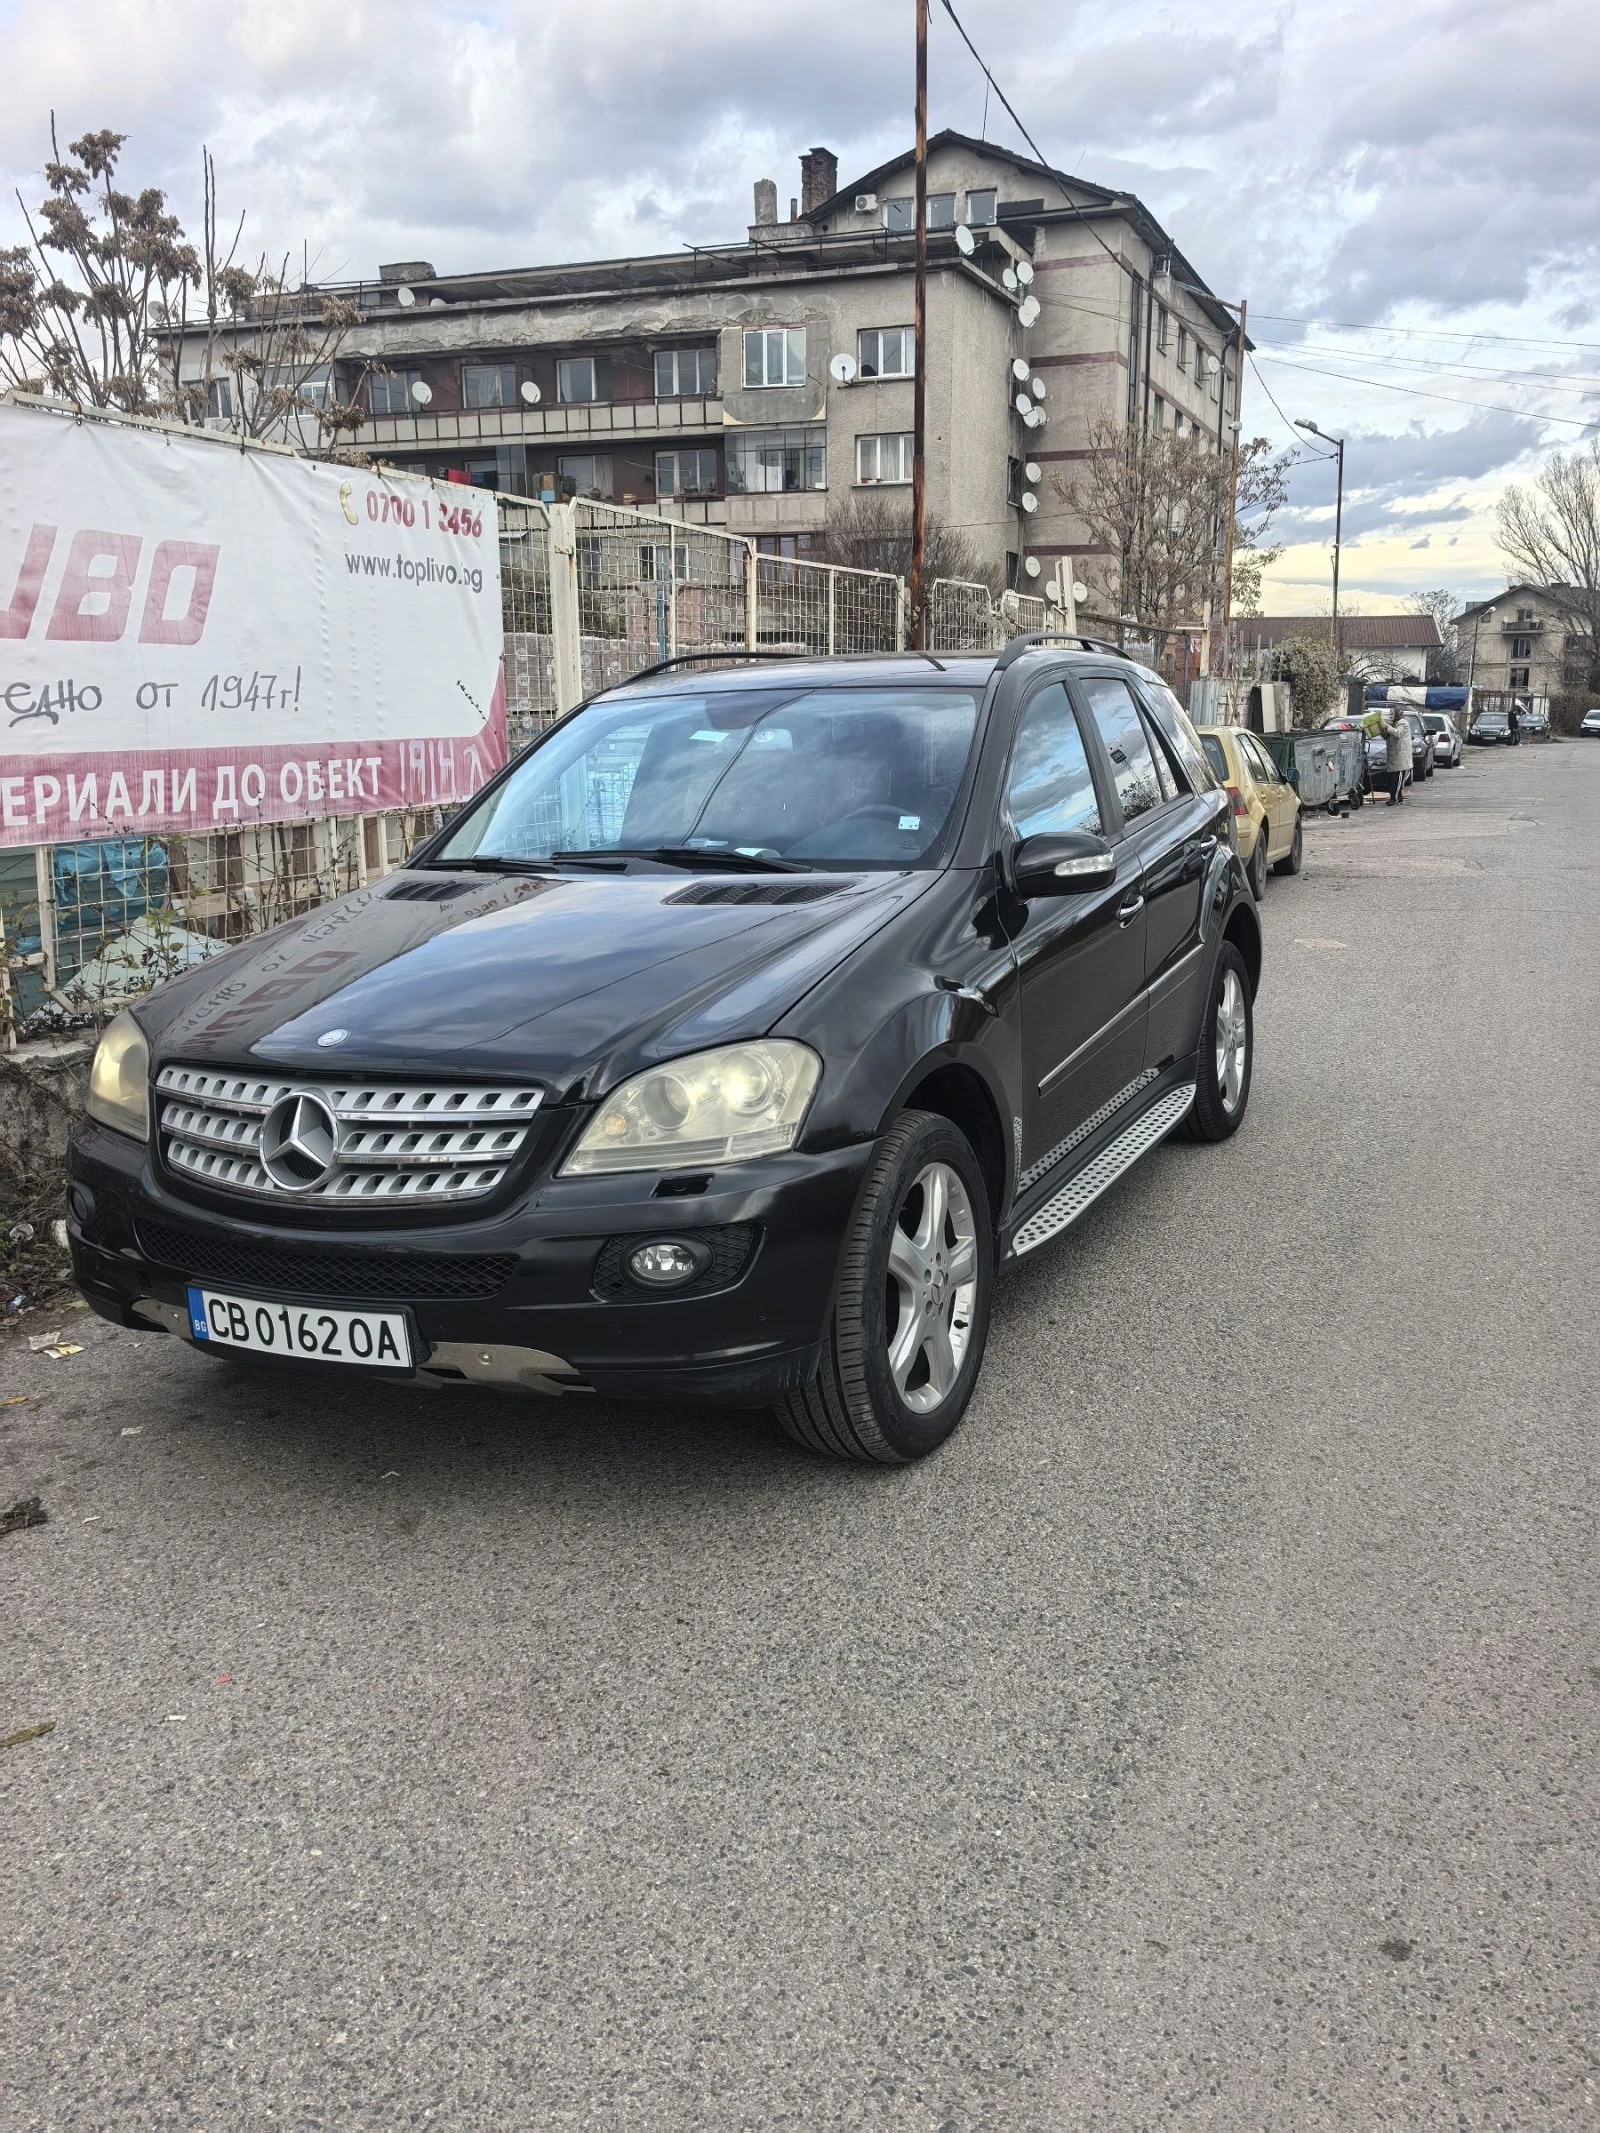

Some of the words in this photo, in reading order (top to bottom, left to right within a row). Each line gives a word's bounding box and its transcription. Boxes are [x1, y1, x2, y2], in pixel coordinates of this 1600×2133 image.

[366, 490, 415, 528] 0700
[422, 499, 430, 529] 1
[438, 503, 483, 538] 3456
[345, 553, 483, 594] www.toplivo.bg
[0, 767, 196, 826] ЕРИАЛИ
[212, 764, 266, 820] ДО
[280, 757, 382, 803] ОБЕКТ
[193, 1319, 207, 1333] BG
